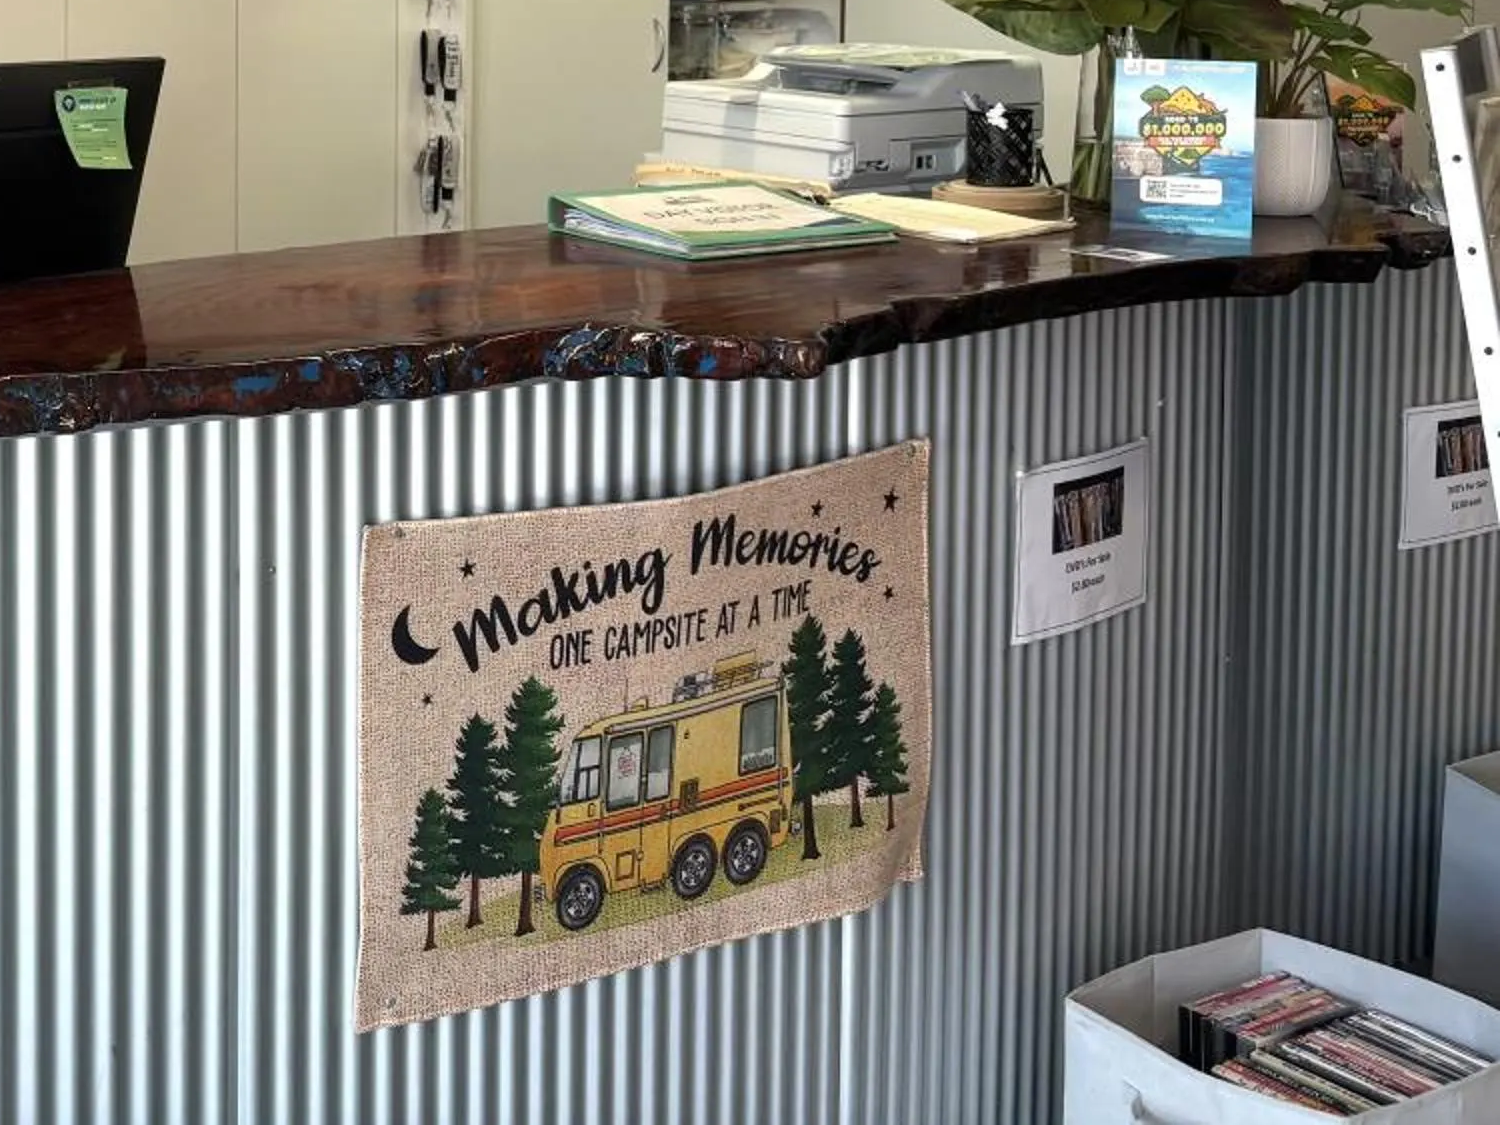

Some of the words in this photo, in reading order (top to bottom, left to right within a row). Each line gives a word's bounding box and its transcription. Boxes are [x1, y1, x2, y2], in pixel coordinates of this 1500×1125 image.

[451, 543, 673, 674] Making
[690, 512, 883, 583] Memories
[548, 630, 593, 671] ONE
[604, 608, 708, 662] CAMPSITE
[715, 600, 742, 637] AT
[747, 600, 762, 629] A
[769, 578, 813, 621] TIME
